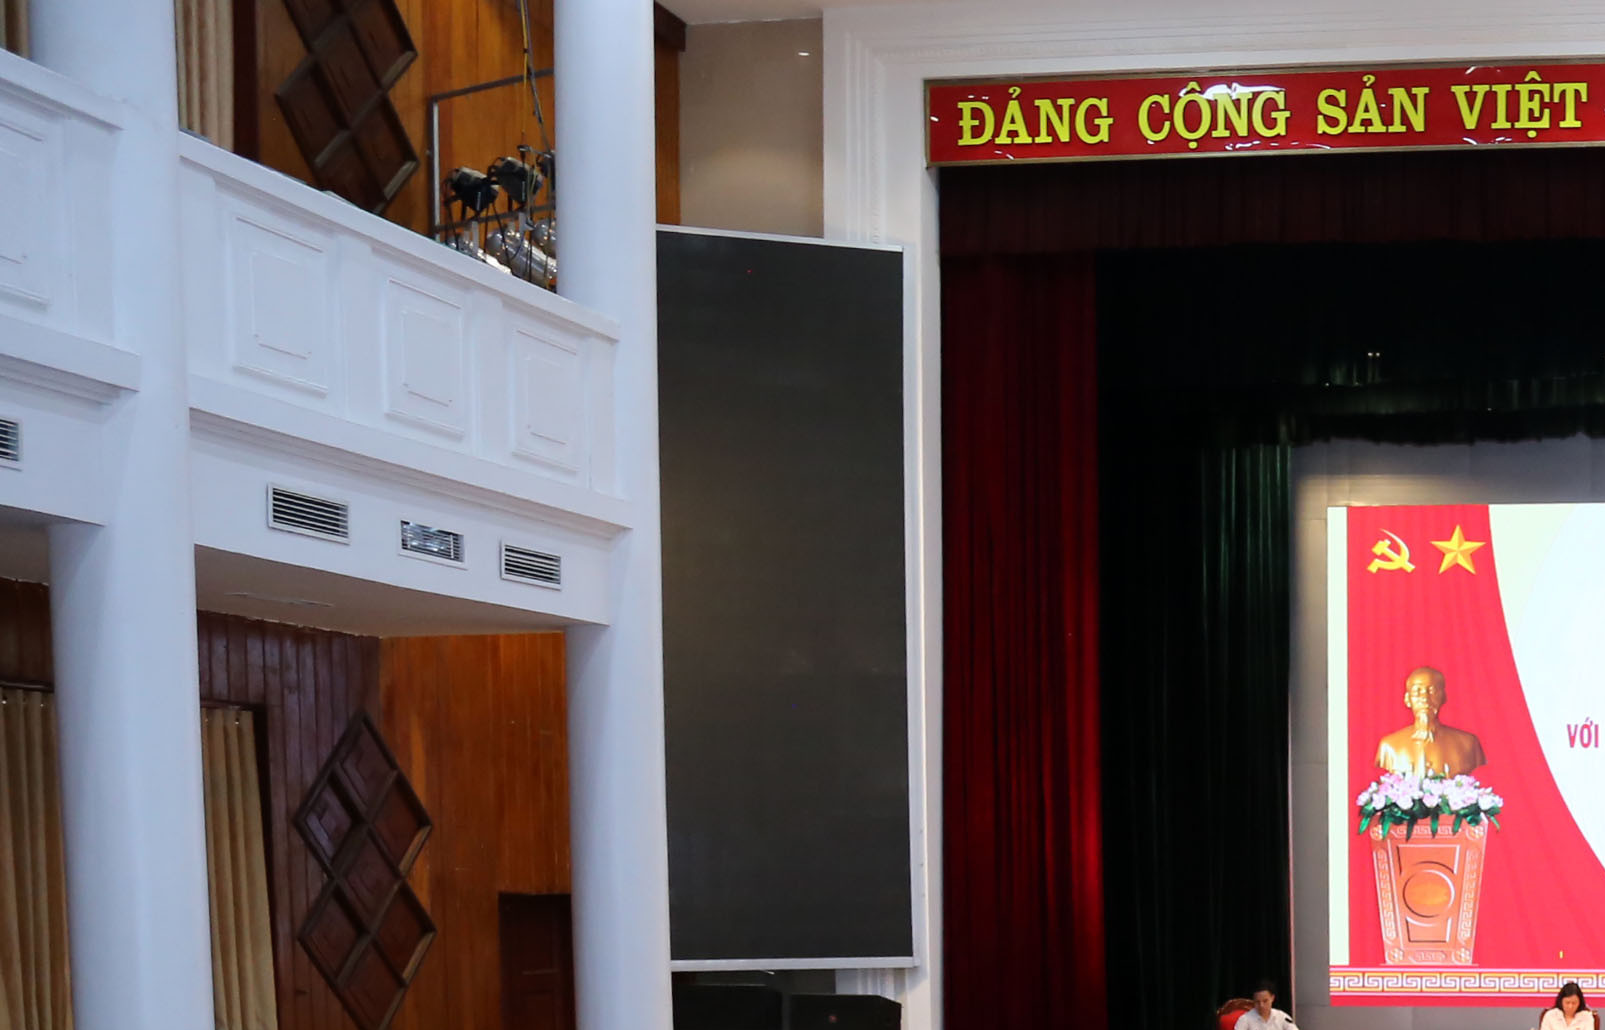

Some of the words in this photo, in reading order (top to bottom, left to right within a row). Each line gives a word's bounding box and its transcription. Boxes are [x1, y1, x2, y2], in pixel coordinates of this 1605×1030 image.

[957, 87, 1114, 146] ĐẢNG
[1138, 84, 1290, 149] CỘNG
[1317, 75, 1429, 135] SẢN
[1450, 71, 1587, 139] VIỆT
[1566, 717, 1599, 748] VỚI
